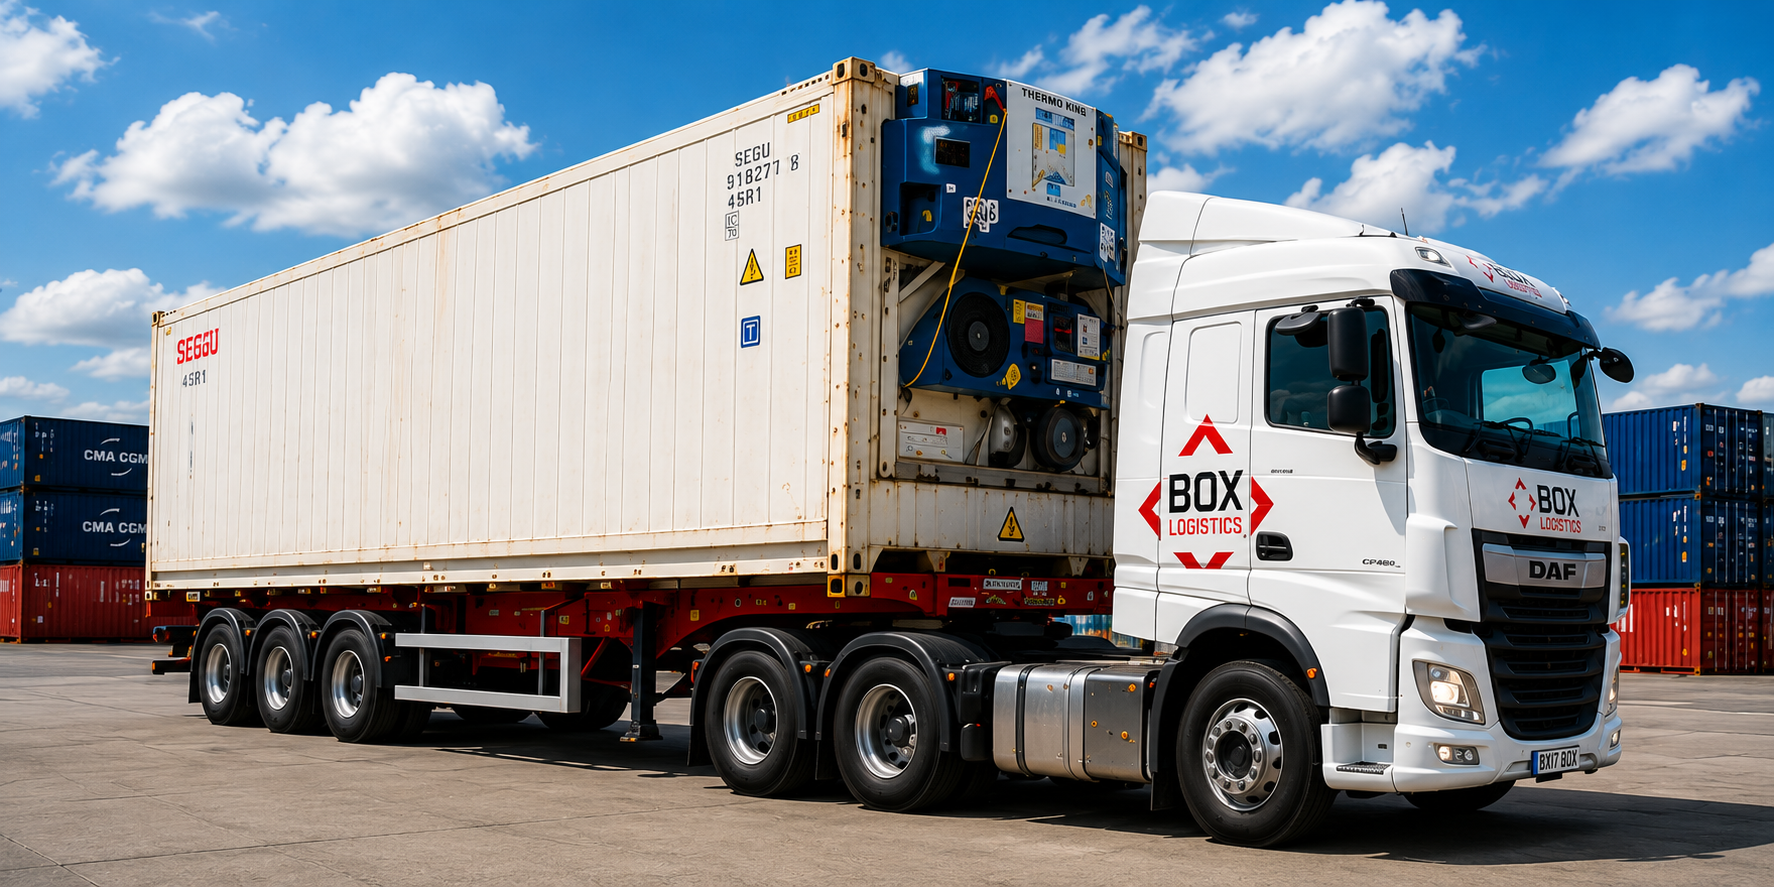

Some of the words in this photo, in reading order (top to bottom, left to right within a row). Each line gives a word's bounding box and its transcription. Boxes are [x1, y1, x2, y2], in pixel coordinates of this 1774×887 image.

[1021, 87, 1063, 109] THERMO
[735, 142, 770, 167] SEGU
[727, 159, 780, 190] 918277
[790, 154, 799, 171] 8
[728, 186, 761, 209] 45R1
[182, 369, 206, 387] 45R1
[84, 449, 116, 462] CMA
[119, 452, 148, 464] CGM
[1169, 469, 1244, 513] BOX
[1536, 484, 1580, 518] BOX
[82, 521, 114, 533] CMA
[118, 522, 147, 534] CGM
[1169, 517, 1242, 536] LOGISTICS
[1540, 516, 1582, 534] LOGISTICS
[1529, 560, 1576, 580] DAF
[1539, 751, 1559, 771] BX17
[1560, 749, 1578, 768] BOX
